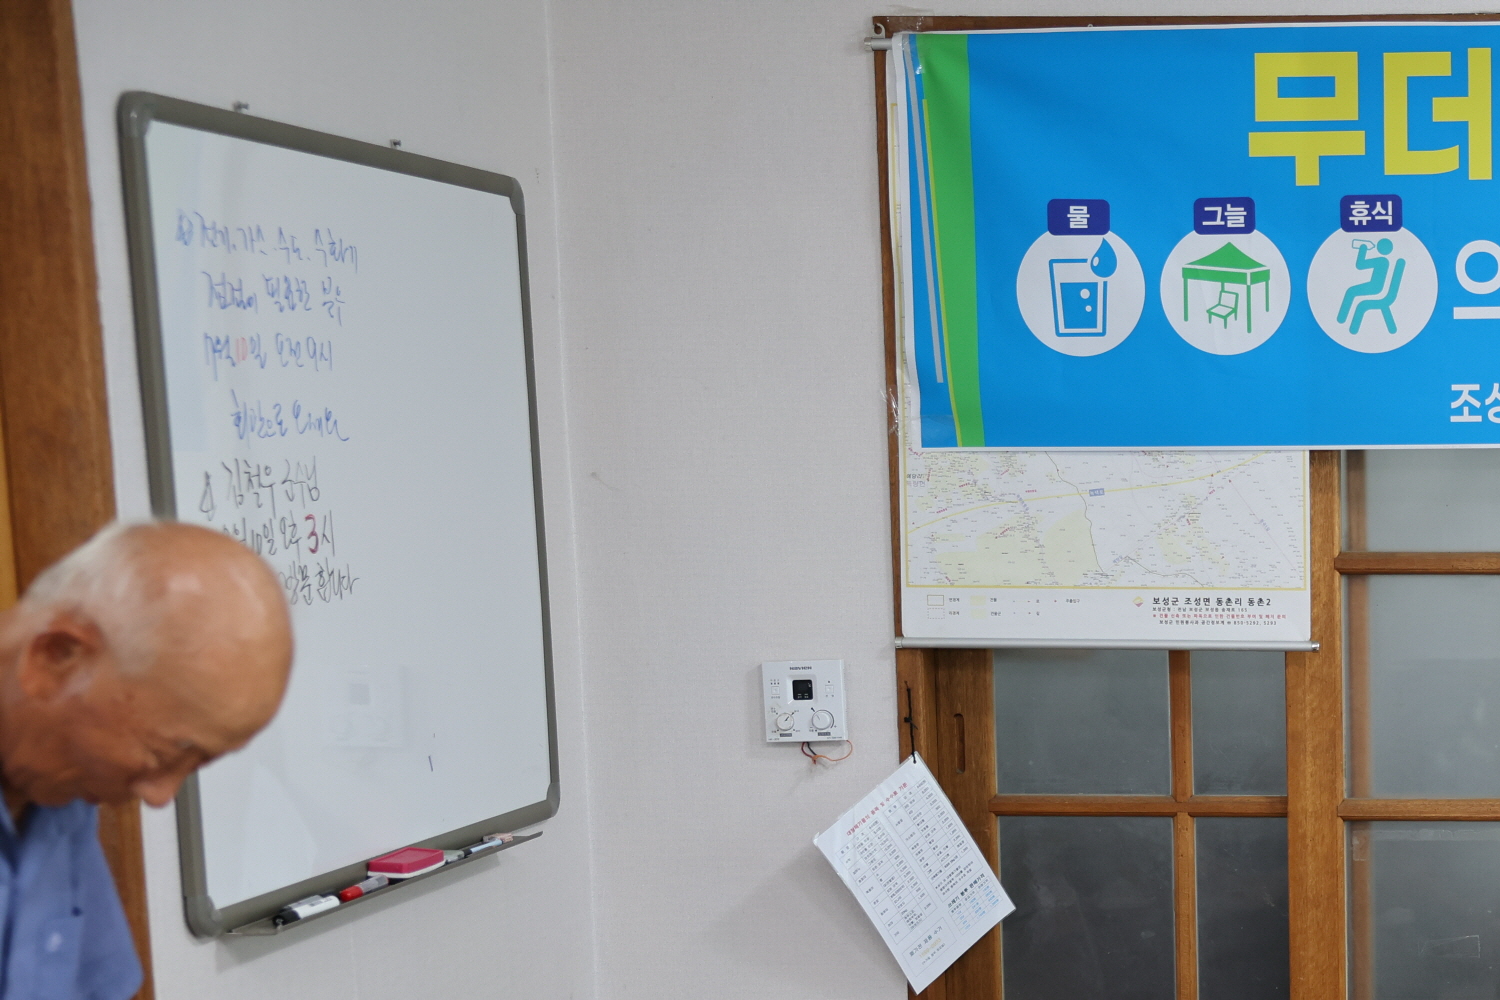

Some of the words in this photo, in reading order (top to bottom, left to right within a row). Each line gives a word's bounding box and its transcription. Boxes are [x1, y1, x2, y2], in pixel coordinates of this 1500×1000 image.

[1066, 205, 1090, 229] 물
[1202, 204, 1247, 228] 그늘
[1348, 199, 1393, 226] 휴식
[305, 510, 335, 557] 3시
[1153, 598, 1179, 606] 보성군
[1184, 598, 1211, 606] 조성면
[1216, 598, 1242, 606] 동촌리
[1248, 598, 1271, 606] 동촌2
